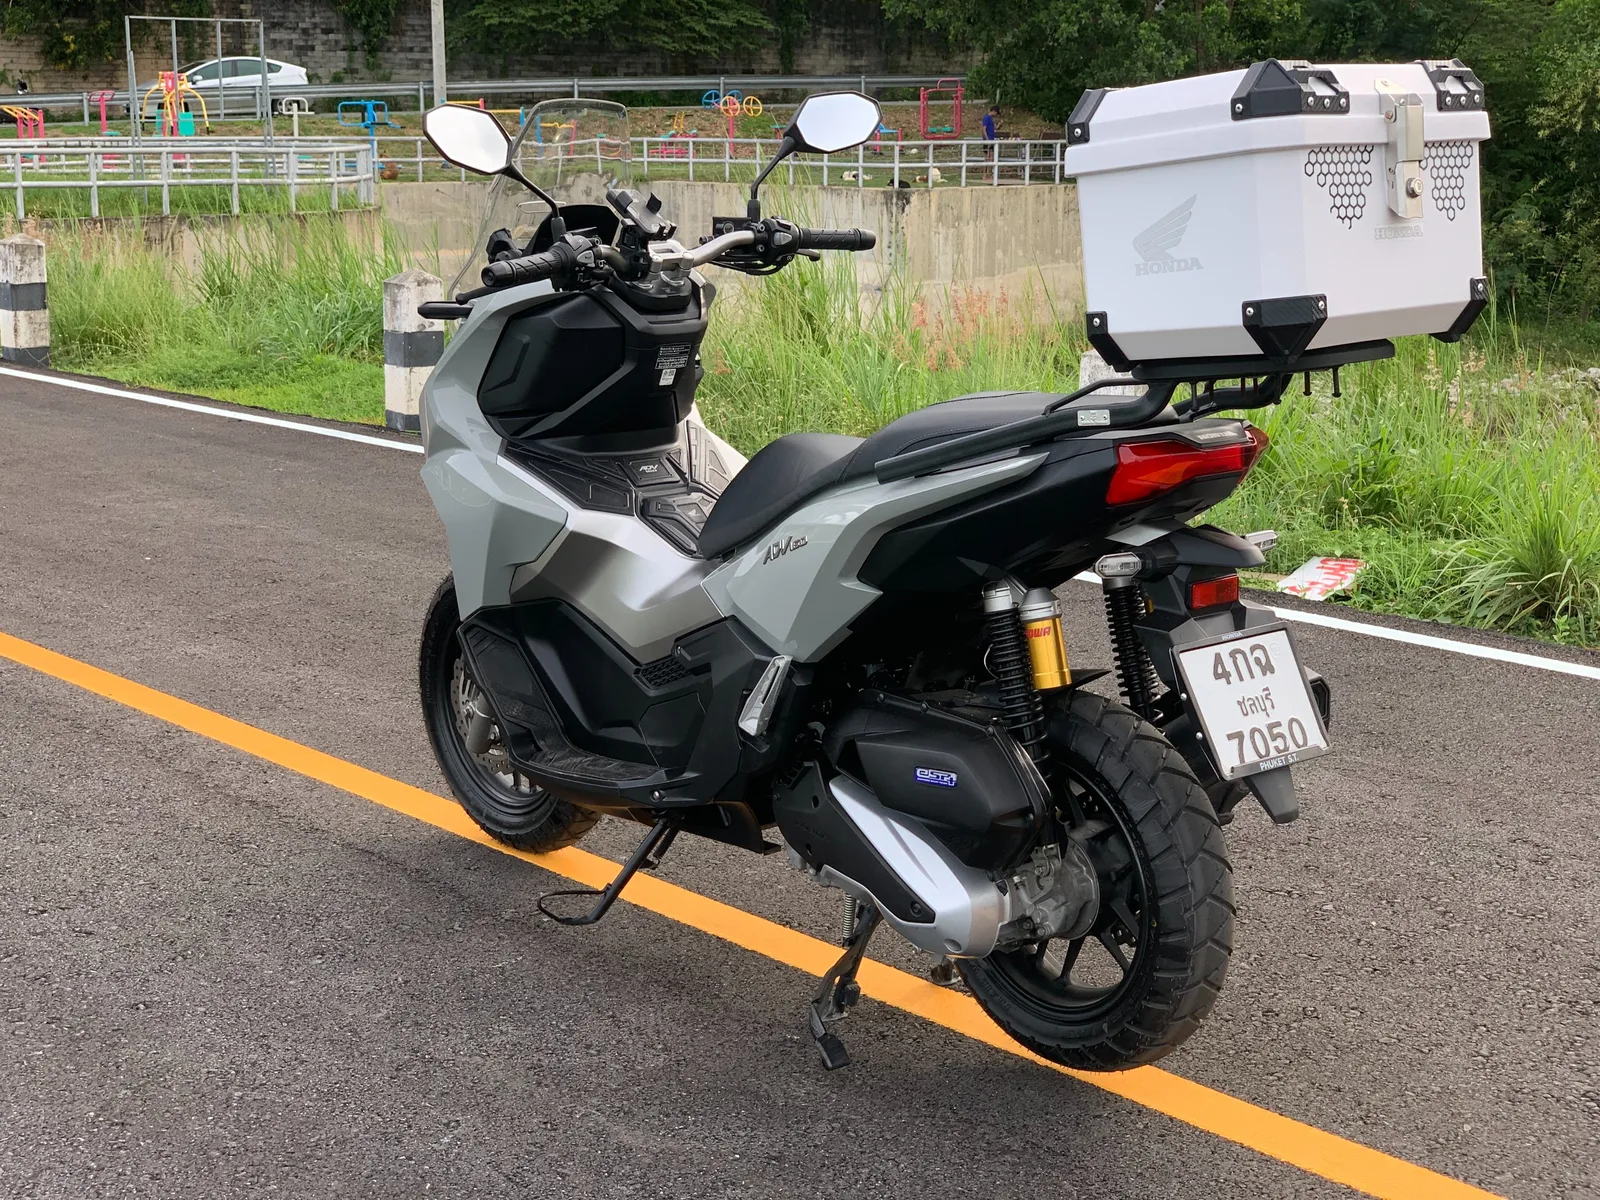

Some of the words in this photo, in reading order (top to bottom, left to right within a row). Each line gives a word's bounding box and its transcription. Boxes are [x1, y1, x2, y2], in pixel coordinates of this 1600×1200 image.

[1374, 225, 1423, 240] HONDA
[1135, 258, 1203, 276] HONDA
[1221, 631, 1243, 641] HONDA
[1237, 687, 1275, 717] ชลบุรี
[1226, 717, 1308, 764] 7050
[1259, 756, 1286, 771] PHUKET
